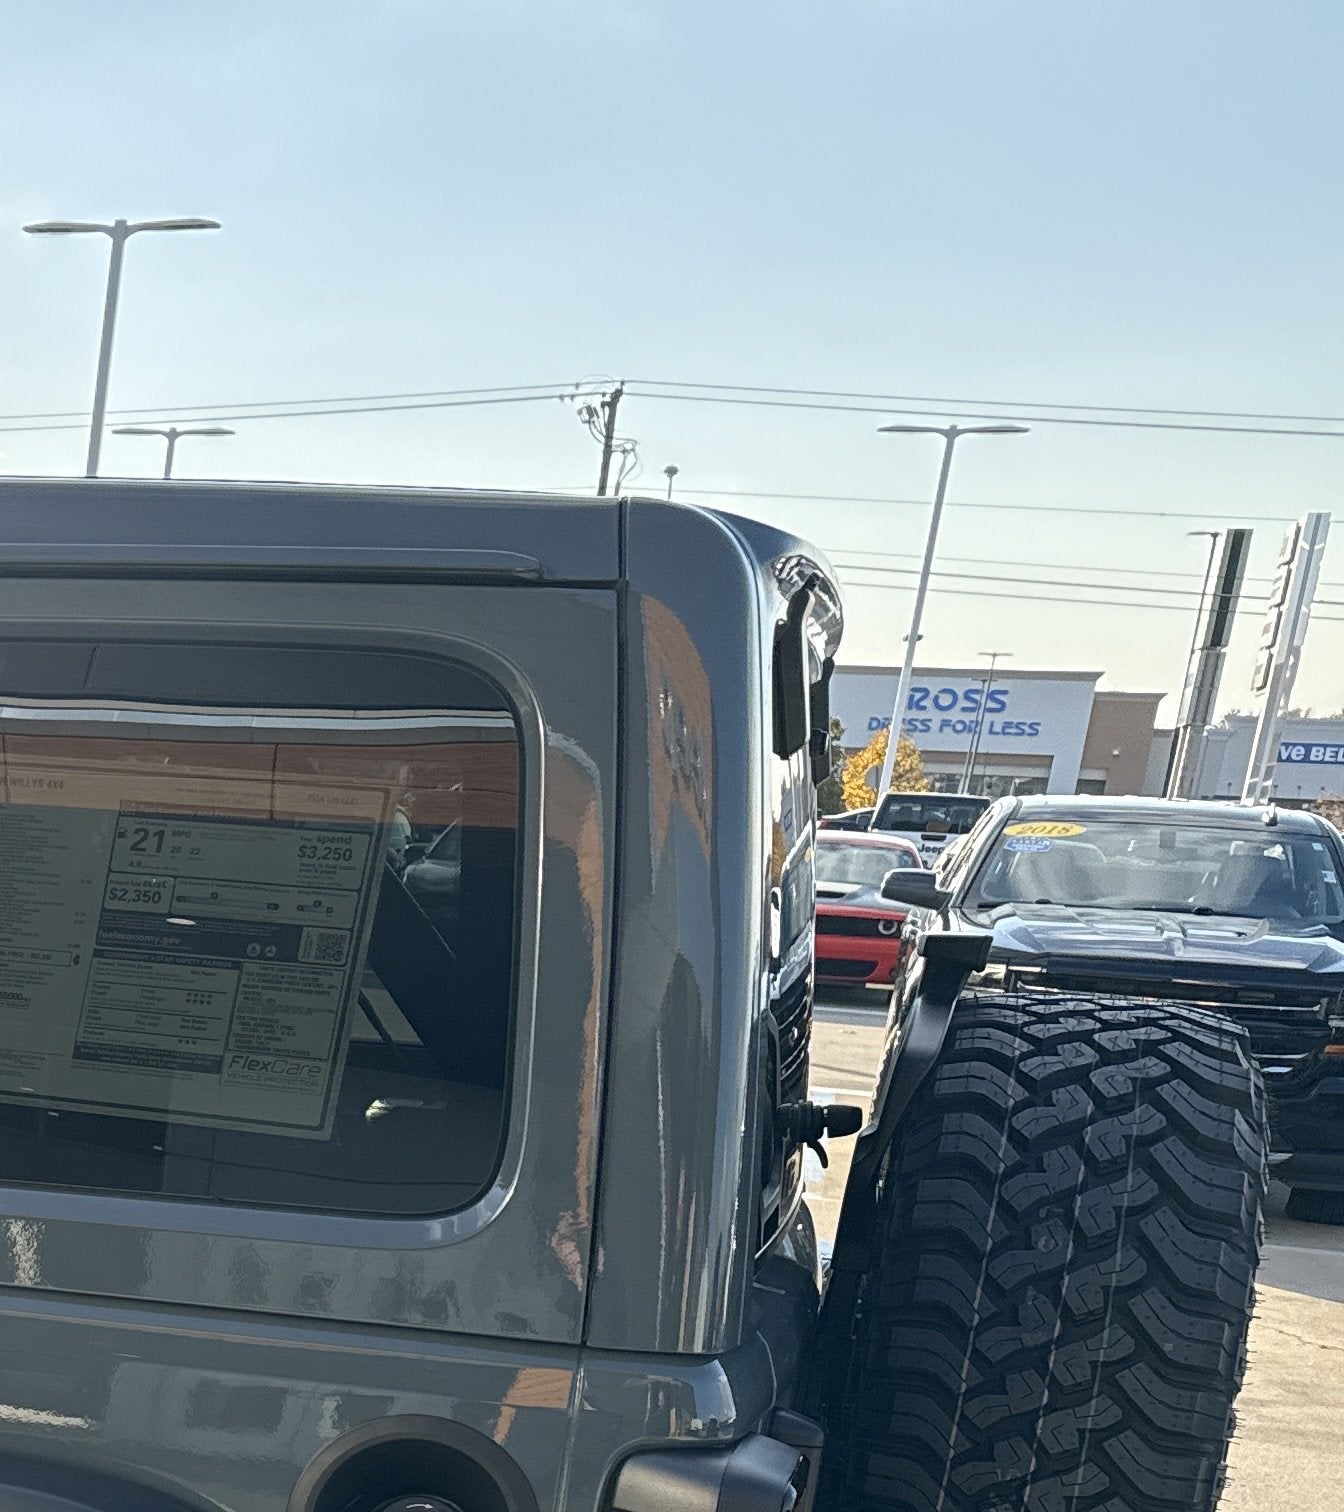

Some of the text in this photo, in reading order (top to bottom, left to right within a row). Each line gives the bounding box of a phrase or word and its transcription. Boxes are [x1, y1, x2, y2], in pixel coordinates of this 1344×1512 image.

[907, 686, 1010, 713] ROSS
[987, 720, 1042, 737] LESS
[1280, 745, 1344, 762] ve BEL
[9, 777, 45, 789] WILLYS
[1015, 825, 1074, 836] 2018
[129, 827, 166, 853] 21
[171, 829, 192, 839] MPG
[316, 835, 353, 846] spend
[189, 847, 202, 856] 22
[297, 844, 354, 863] $3,250
[108, 887, 163, 904] $2,350
[228, 1053, 322, 1079] FlexCare
